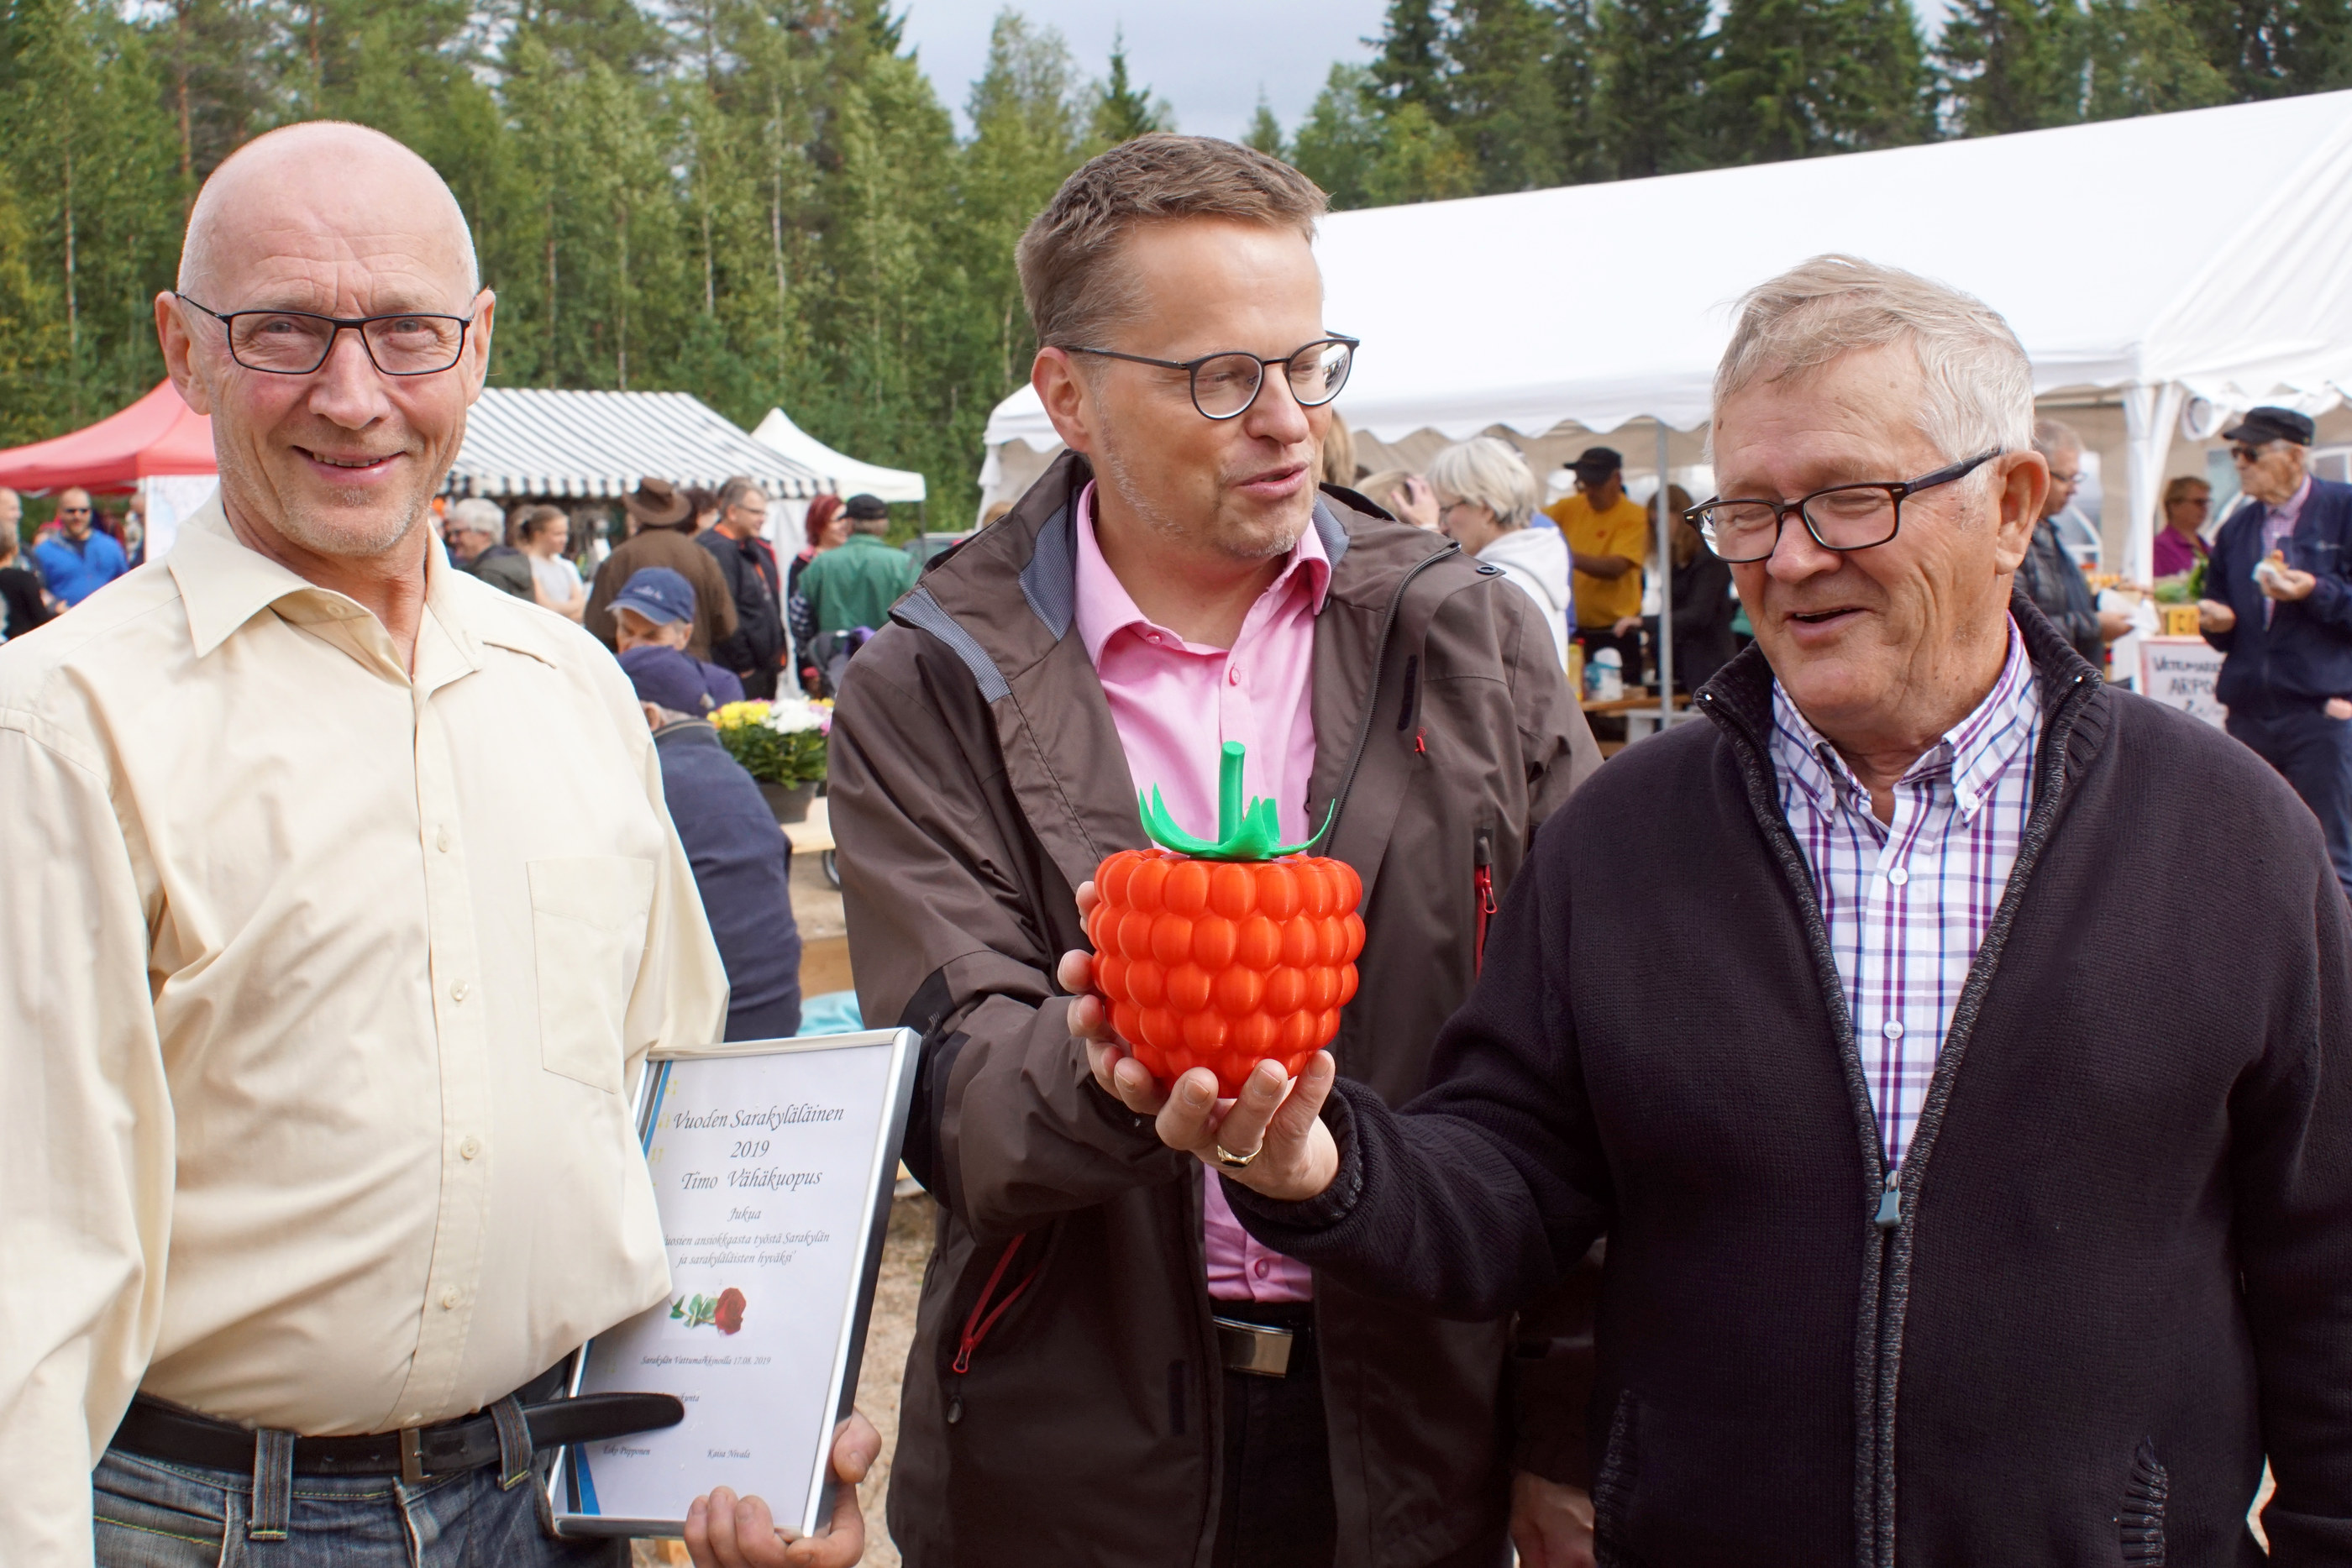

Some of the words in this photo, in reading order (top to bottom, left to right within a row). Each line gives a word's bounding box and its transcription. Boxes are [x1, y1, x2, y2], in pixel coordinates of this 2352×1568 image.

[673, 1109, 728, 1130] Vuoden
[730, 1104, 844, 1131] Sarakyläläinen
[730, 1140, 770, 1158] 2019
[681, 1171, 718, 1191] Timo
[727, 1167, 823, 1192] Vähäkuopus
[727, 1207, 762, 1223] Jukua
[753, 1233, 782, 1249] työstä
[782, 1230, 830, 1246] Sarakylän
[676, 1257, 688, 1269] ja
[689, 1253, 755, 1268] sarakyläläisten
[640, 1356, 673, 1366] Sarakylän
[674, 1354, 732, 1366] Vattumarkkinoilla
[754, 1356, 772, 1365] 2019
